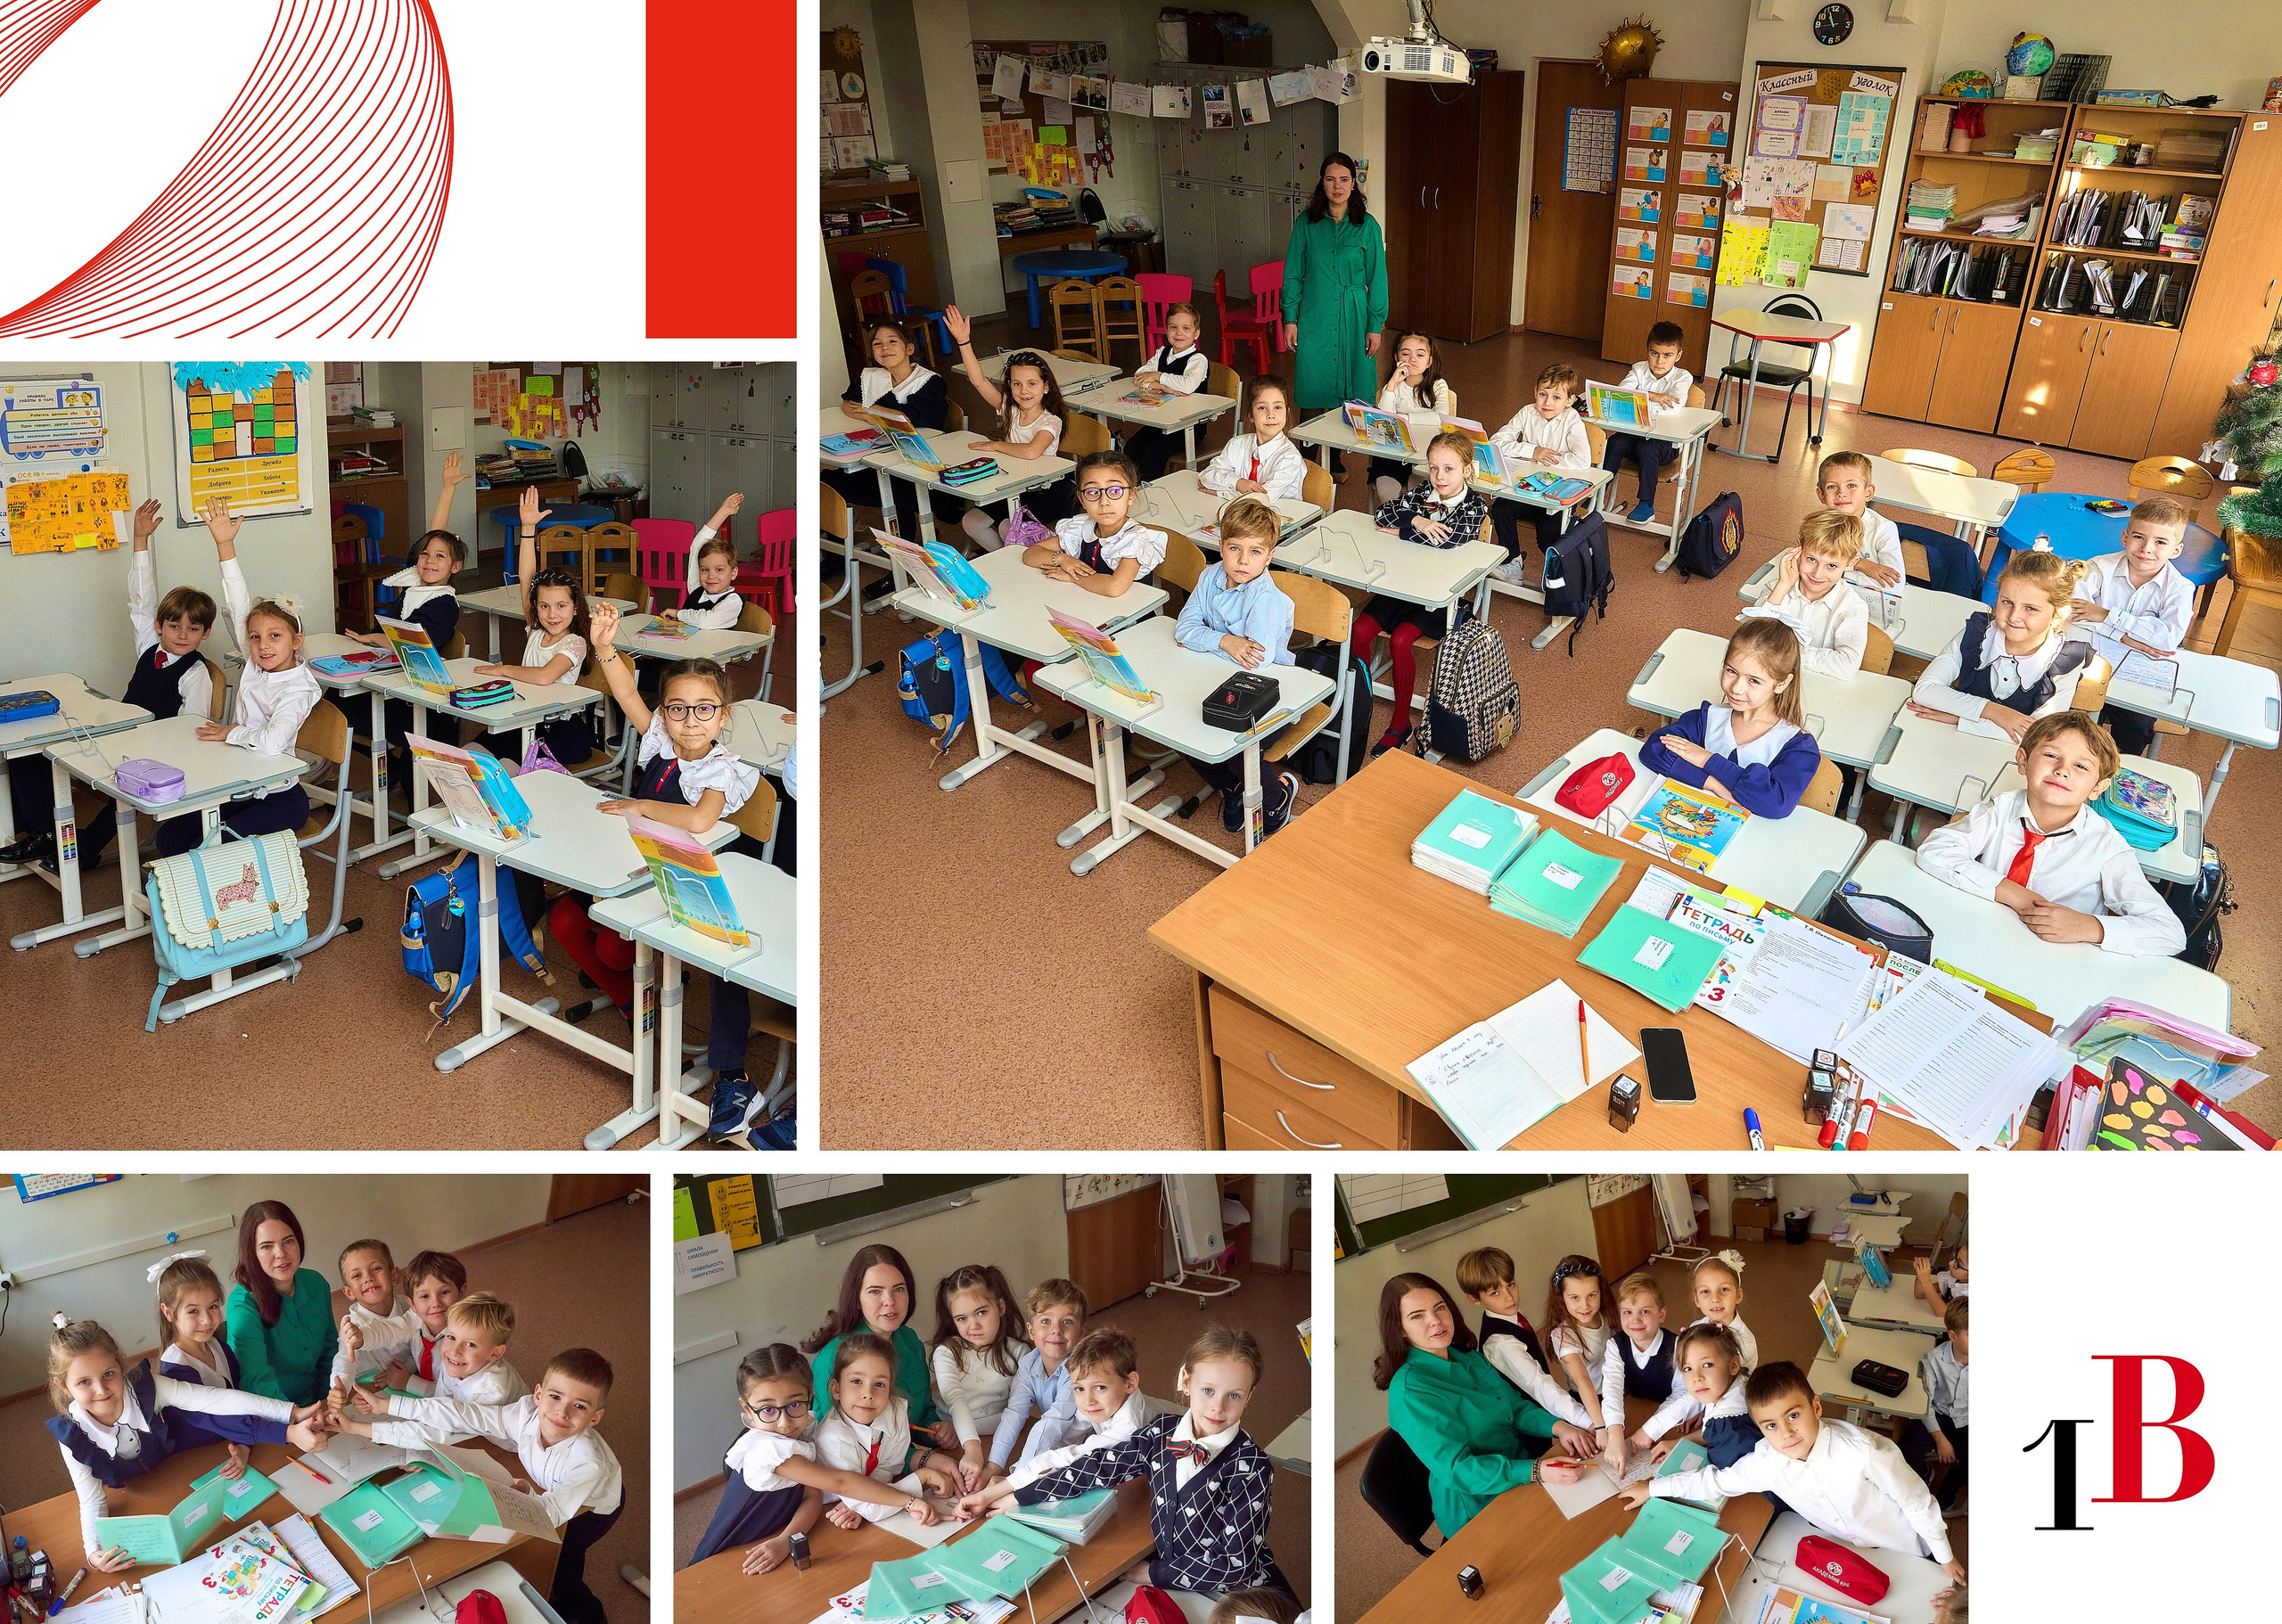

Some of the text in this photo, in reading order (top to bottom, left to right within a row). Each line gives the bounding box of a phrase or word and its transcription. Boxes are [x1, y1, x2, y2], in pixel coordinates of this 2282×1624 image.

[1760, 70, 1894, 97] Классный уголок
[260, 488, 286, 496] Уважение
[1682, 905, 1755, 945] ТЕТРАДЬ
[1708, 988, 1725, 1002] 3
[688, 1249, 719, 1260] САМООЦЕНКИ
[691, 1260, 724, 1273] ПРАВИЛЬНОСТЬ
[693, 1267, 724, 1279] АККУРАТНОСТЬ
[211, 1546, 224, 1559] 2
[1812, 1566, 1840, 1584] АКАДЕМИЯ
[202, 1577, 218, 1588] 3
[256, 1573, 300, 1620] ТЕТРАДЬ
[836, 1597, 853, 1608] 3
